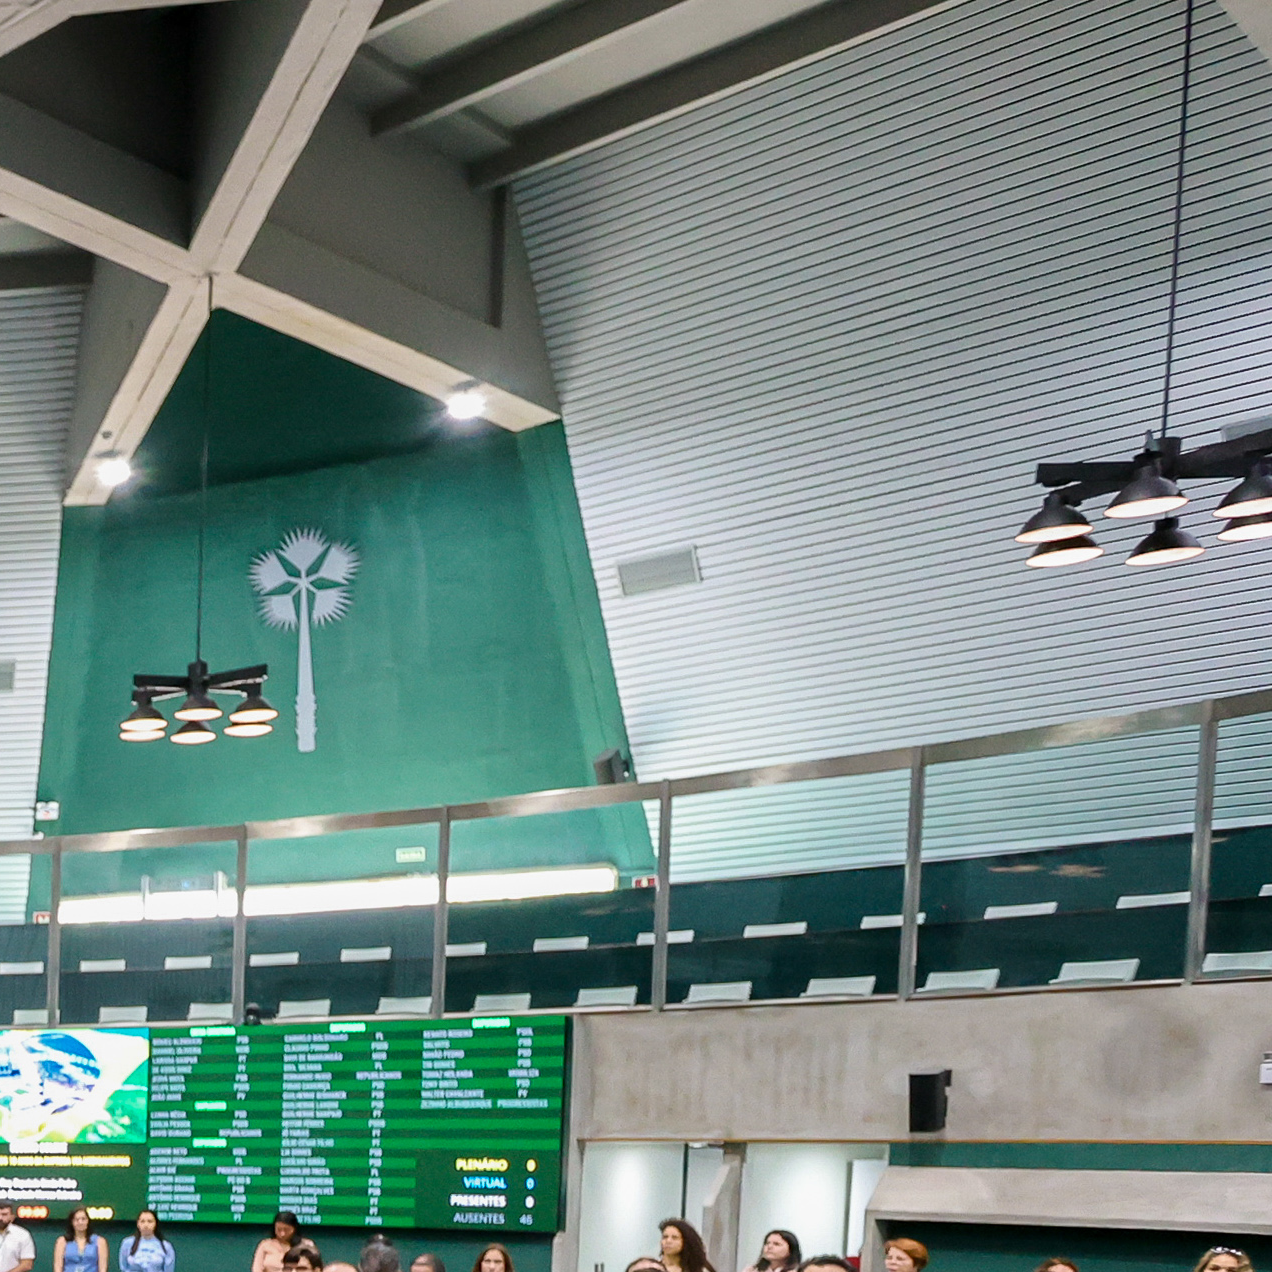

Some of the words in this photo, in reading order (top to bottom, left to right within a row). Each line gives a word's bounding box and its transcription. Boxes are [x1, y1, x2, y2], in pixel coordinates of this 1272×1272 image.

[456, 1156, 509, 1172] PLENÁRIO
[463, 1176, 508, 1189] VIRTUAL
[525, 1177, 535, 1190] 0
[450, 1193, 507, 1208] PRESENTES
[524, 1195, 535, 1208] 0
[453, 1212, 505, 1225] AUSENTES
